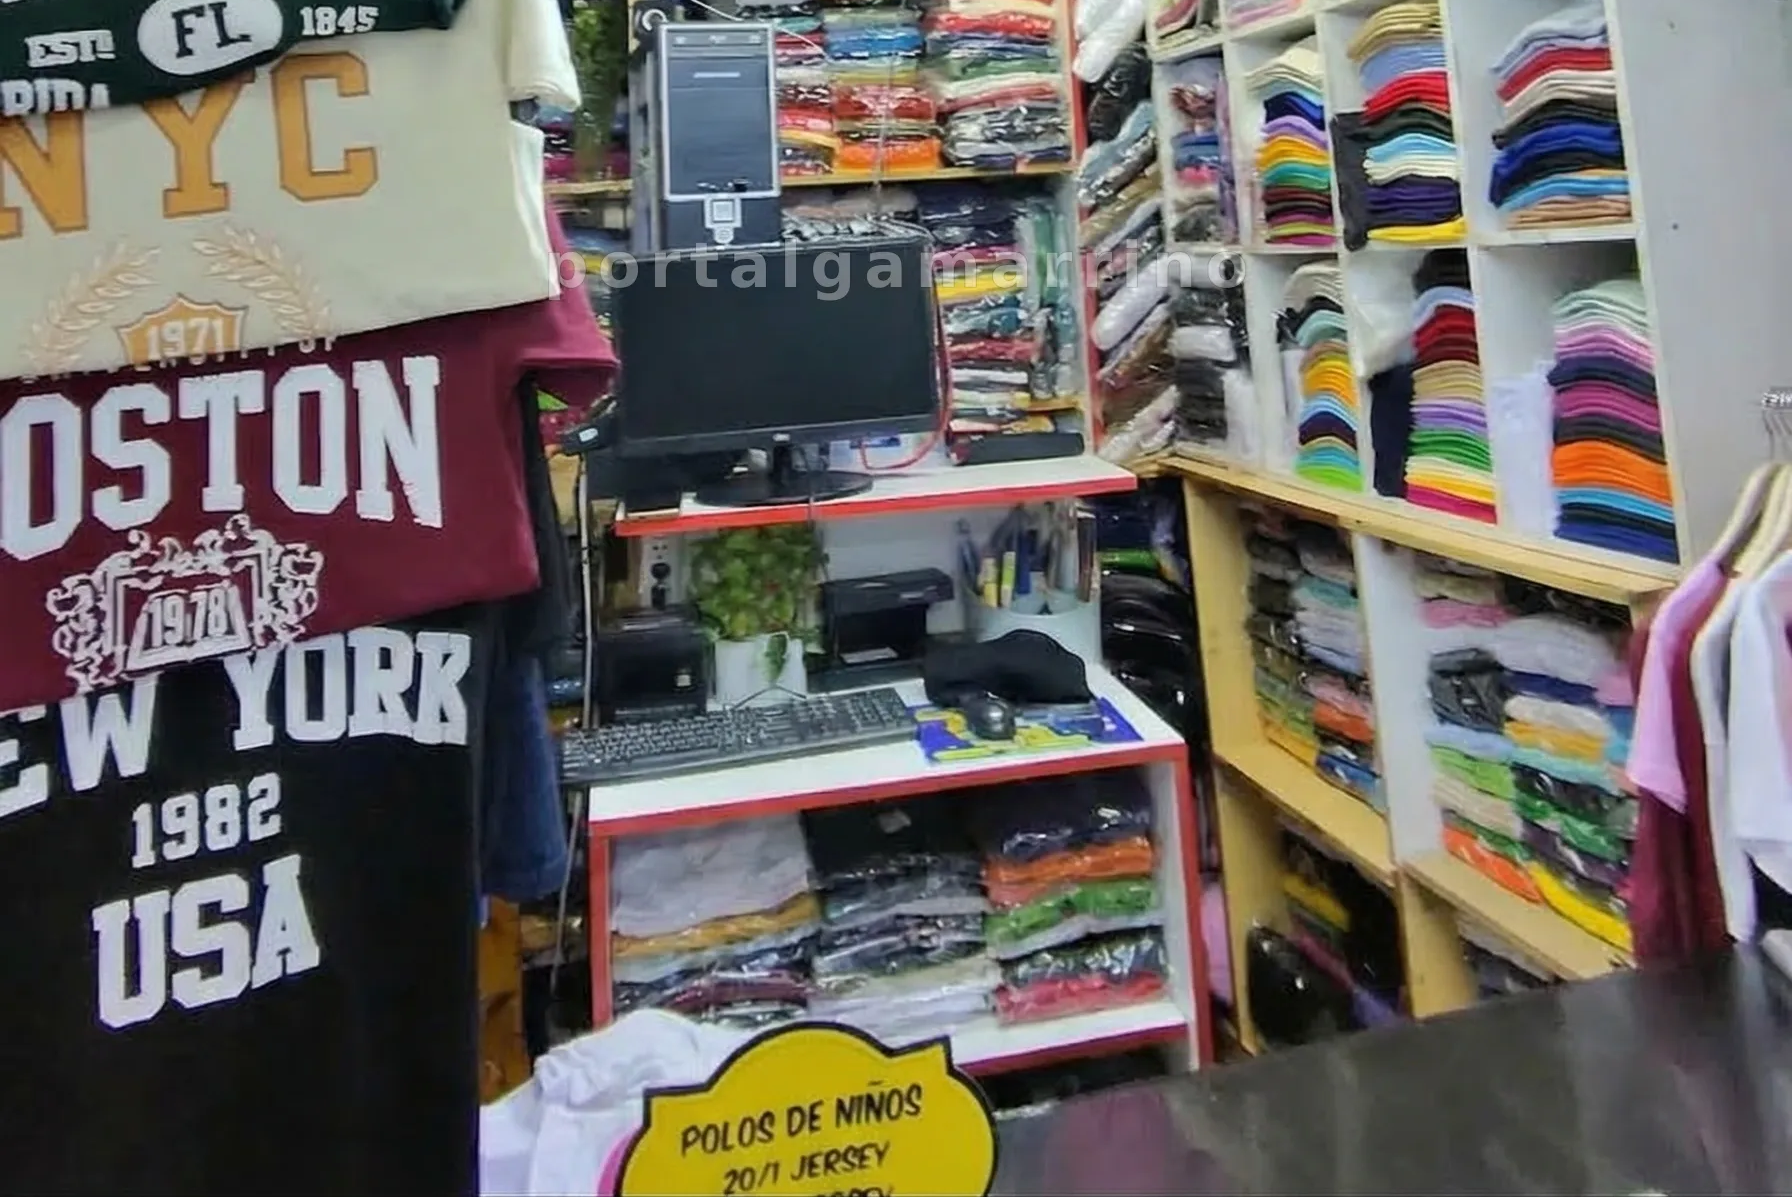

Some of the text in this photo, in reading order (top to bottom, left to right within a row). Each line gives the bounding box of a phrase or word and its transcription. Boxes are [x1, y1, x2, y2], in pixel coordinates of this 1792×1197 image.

[171, 1, 252, 59] FL
[300, 5, 380, 37] 1845
[0, 49, 379, 240] NYC
[146, 315, 225, 363] 1971
[0, 356, 443, 562] OSTON
[146, 586, 231, 647] 1978
[221, 626, 472, 752] YORK
[131, 771, 283, 870] 1982
[92, 854, 321, 1028] USA
[681, 1080, 923, 1157] POLOS DE NIÑOS
[722, 1141, 891, 1196] 20/1 JERSEY
